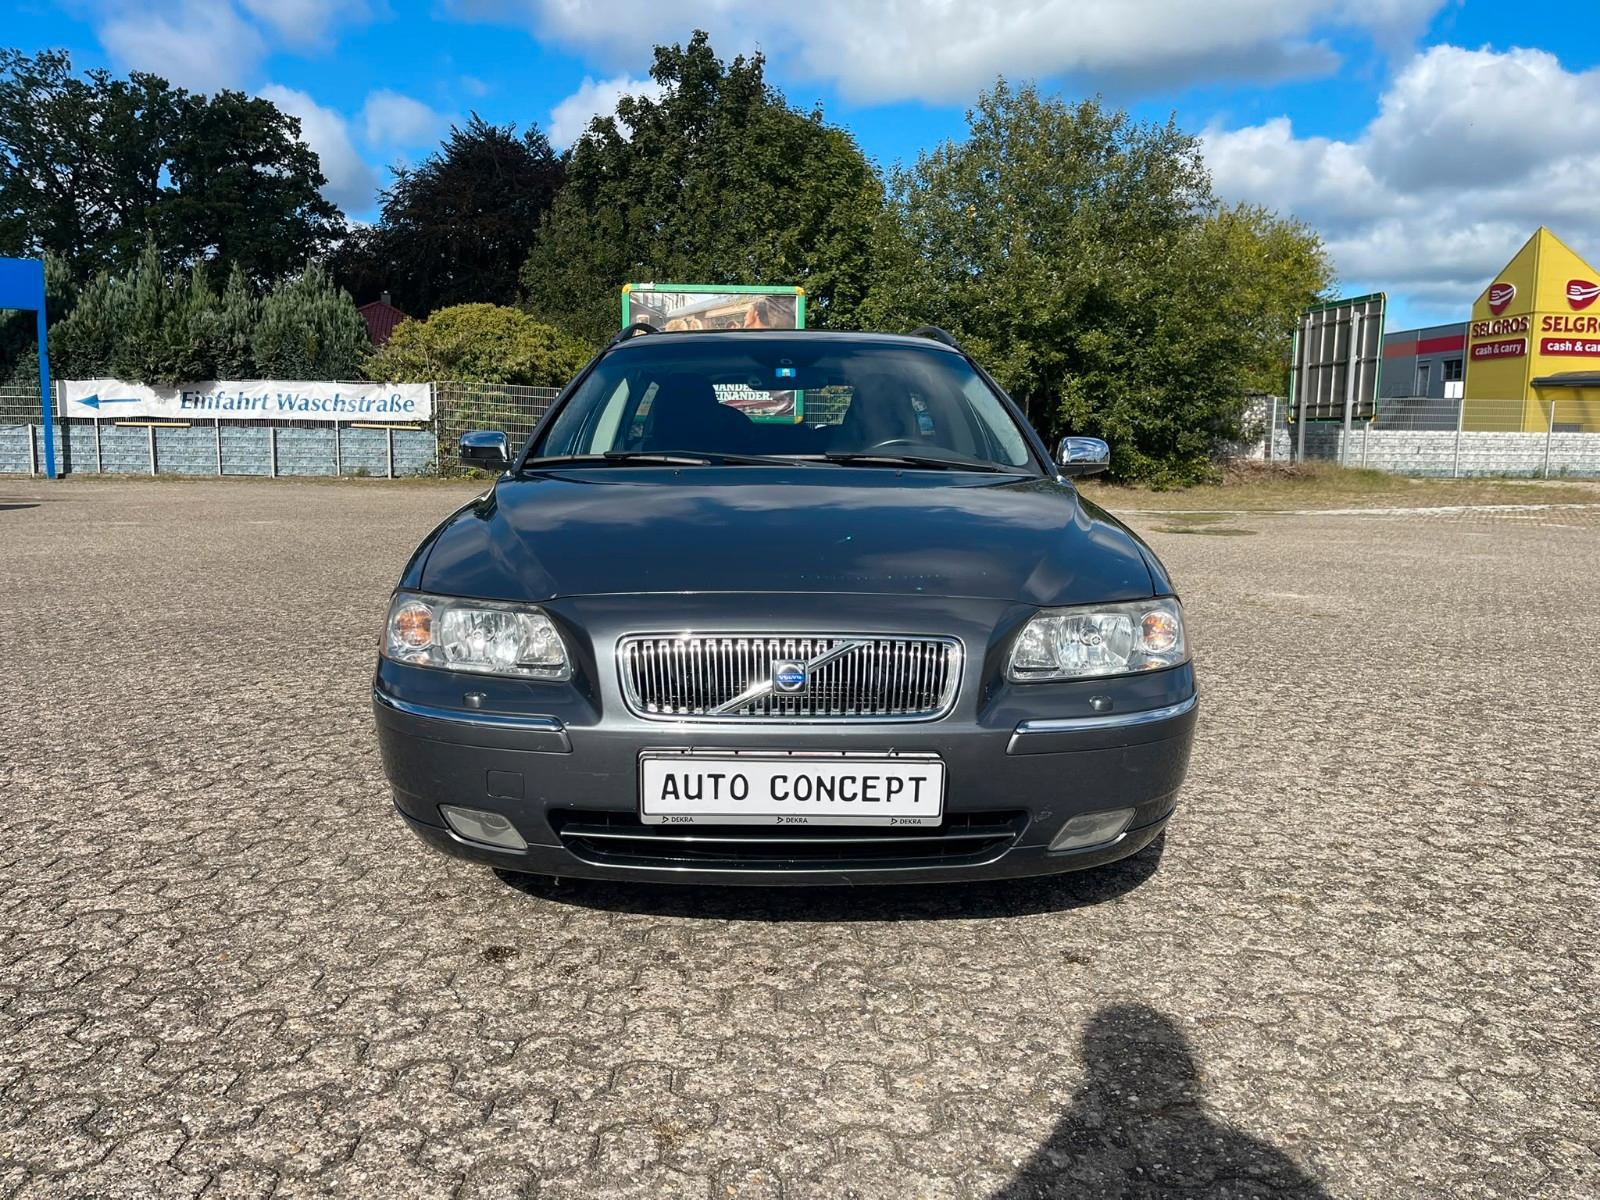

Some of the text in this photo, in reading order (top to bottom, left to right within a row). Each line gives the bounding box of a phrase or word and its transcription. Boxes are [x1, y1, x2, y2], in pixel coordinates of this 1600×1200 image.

[1472, 316, 1529, 338] SELGROS
[1541, 315, 1600, 334] SELGR
[1475, 343, 1522, 356] cash & carry
[1547, 341, 1572, 351] cash
[1574, 341, 1584, 352] &
[180, 390, 416, 413] Einfahrt Waschstraße
[660, 773, 928, 803] AUTO CONCEPT
[671, 816, 695, 824] DEKRA
[785, 816, 809, 824] DEKRA
[899, 817, 922, 825] DEKRA
